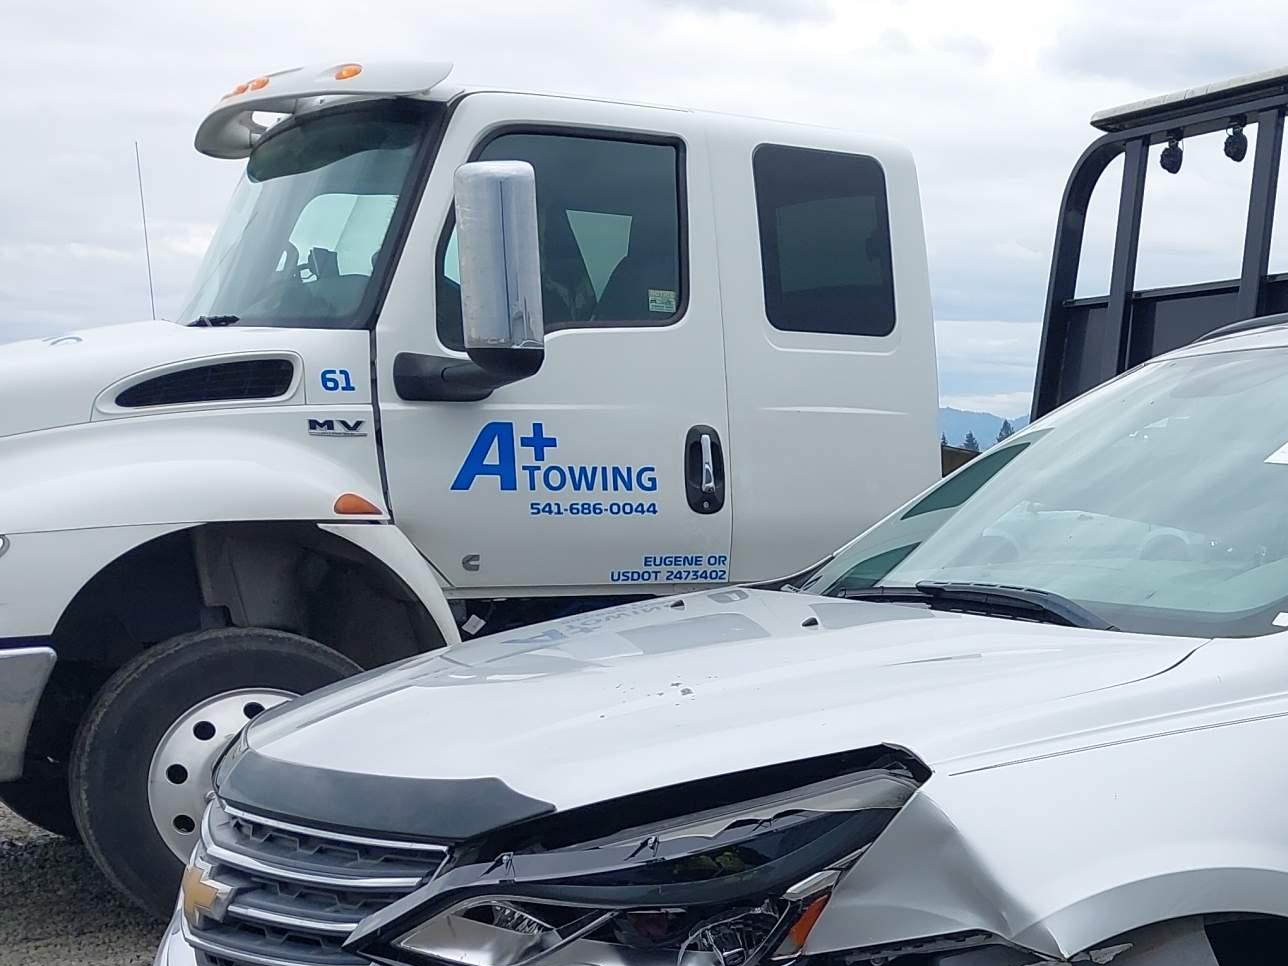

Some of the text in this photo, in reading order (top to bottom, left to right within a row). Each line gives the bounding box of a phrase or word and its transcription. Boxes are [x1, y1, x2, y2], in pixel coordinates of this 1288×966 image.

[320, 369, 356, 392] 61
[308, 419, 365, 431] MV
[521, 464, 658, 492] TOWING
[530, 502, 658, 516] 541-686-0044
[643, 555, 728, 567] EUGENE OR
[610, 569, 728, 582] USDOT 2473402
